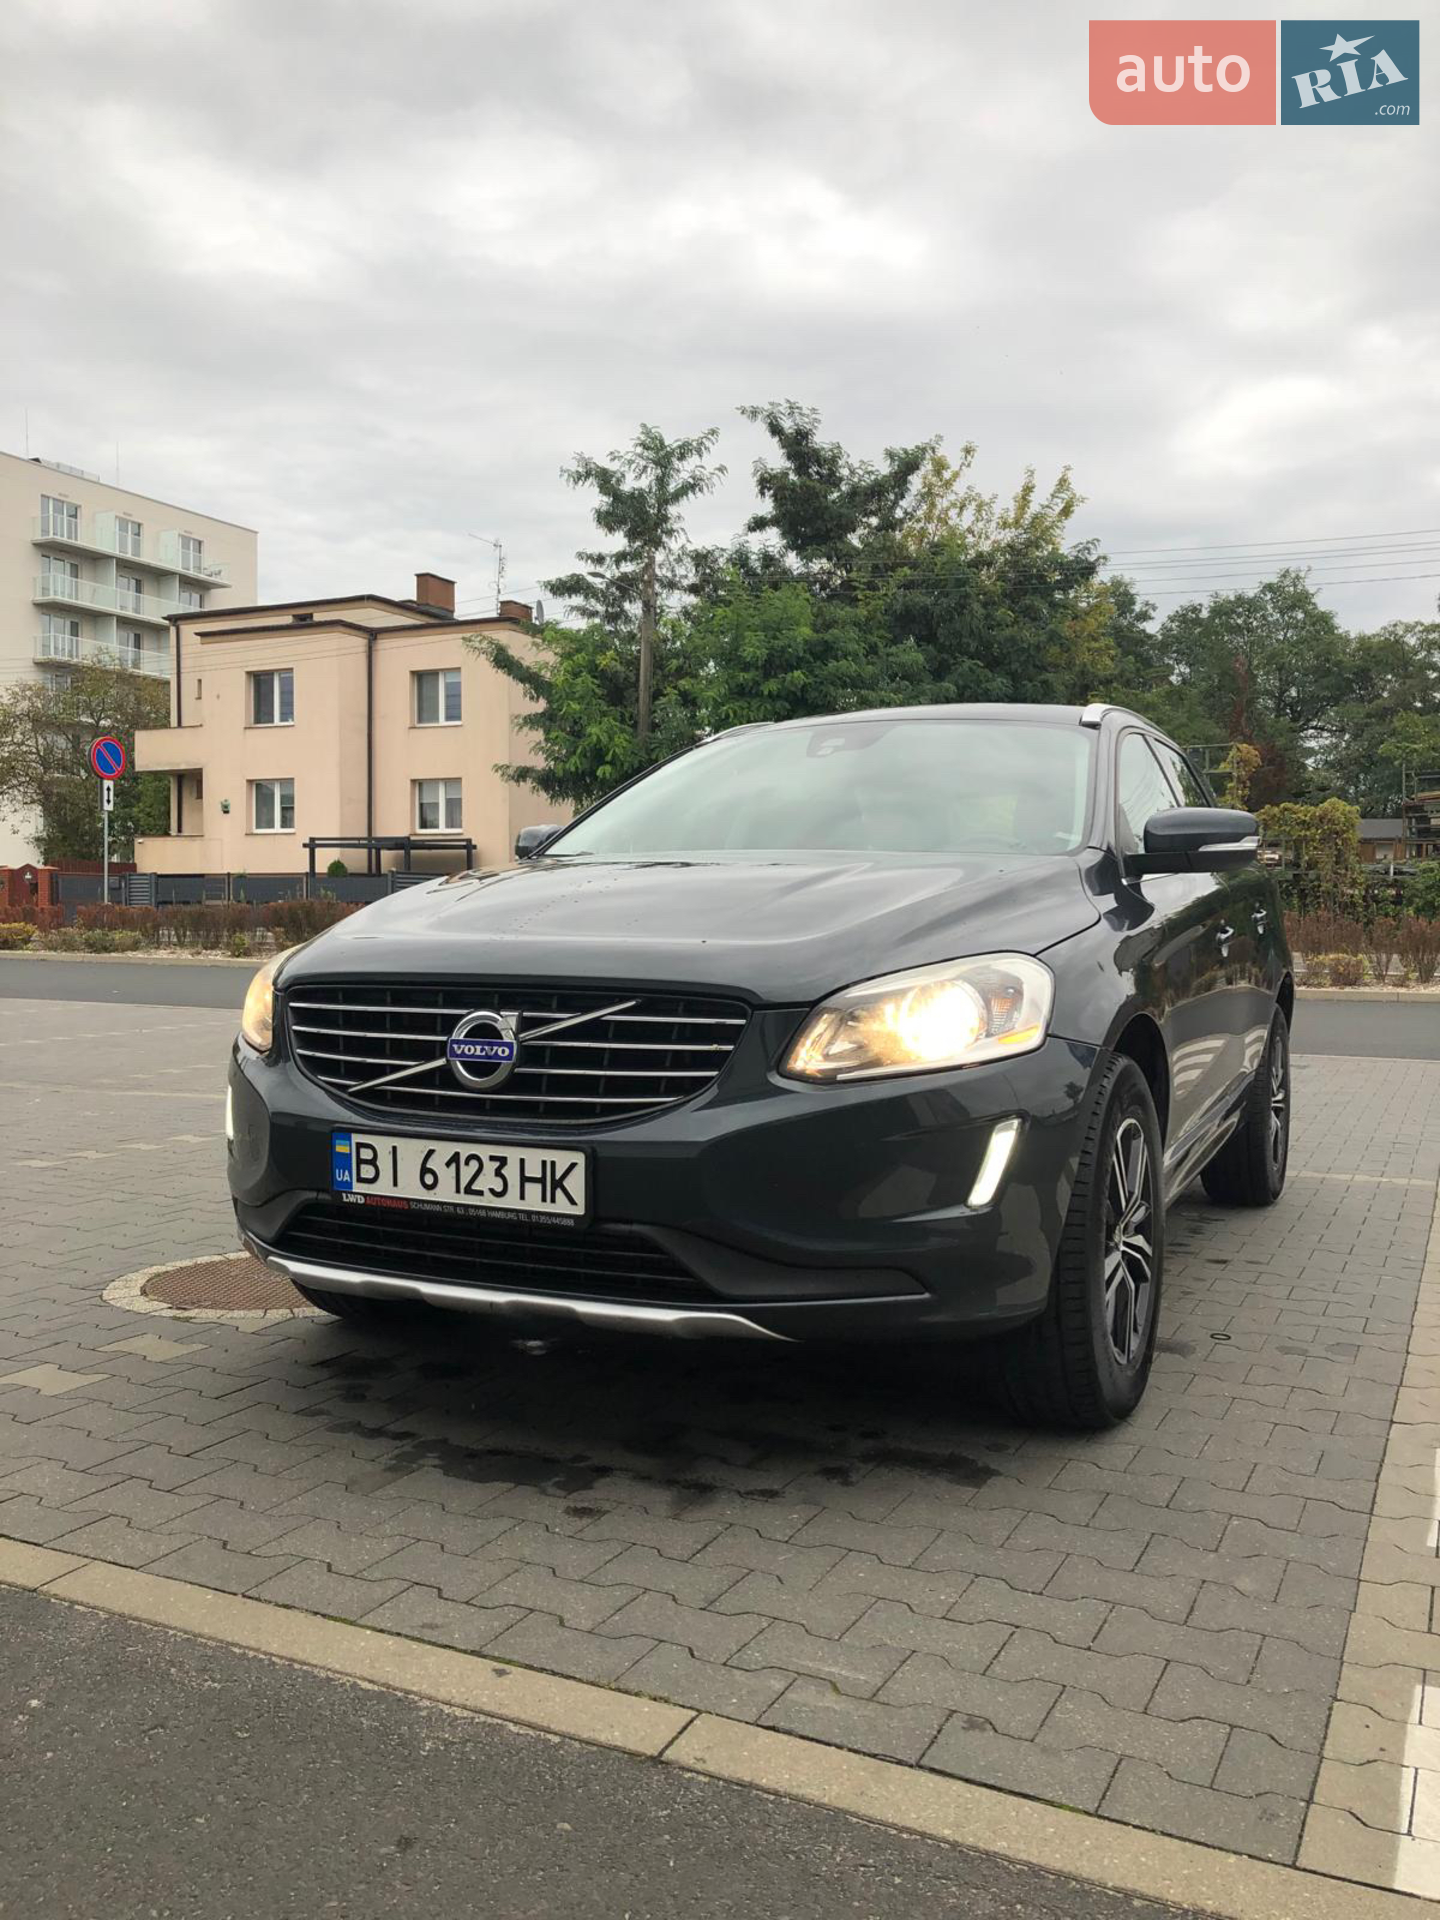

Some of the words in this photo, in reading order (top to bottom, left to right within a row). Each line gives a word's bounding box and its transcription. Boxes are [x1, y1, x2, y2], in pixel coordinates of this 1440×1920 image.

[452, 1044, 510, 1057] VOLVO
[355, 1141, 398, 1188] BI
[335, 1168, 351, 1183] UA
[341, 1192, 366, 1205] LWD
[365, 1195, 410, 1210] AUTOHAUS
